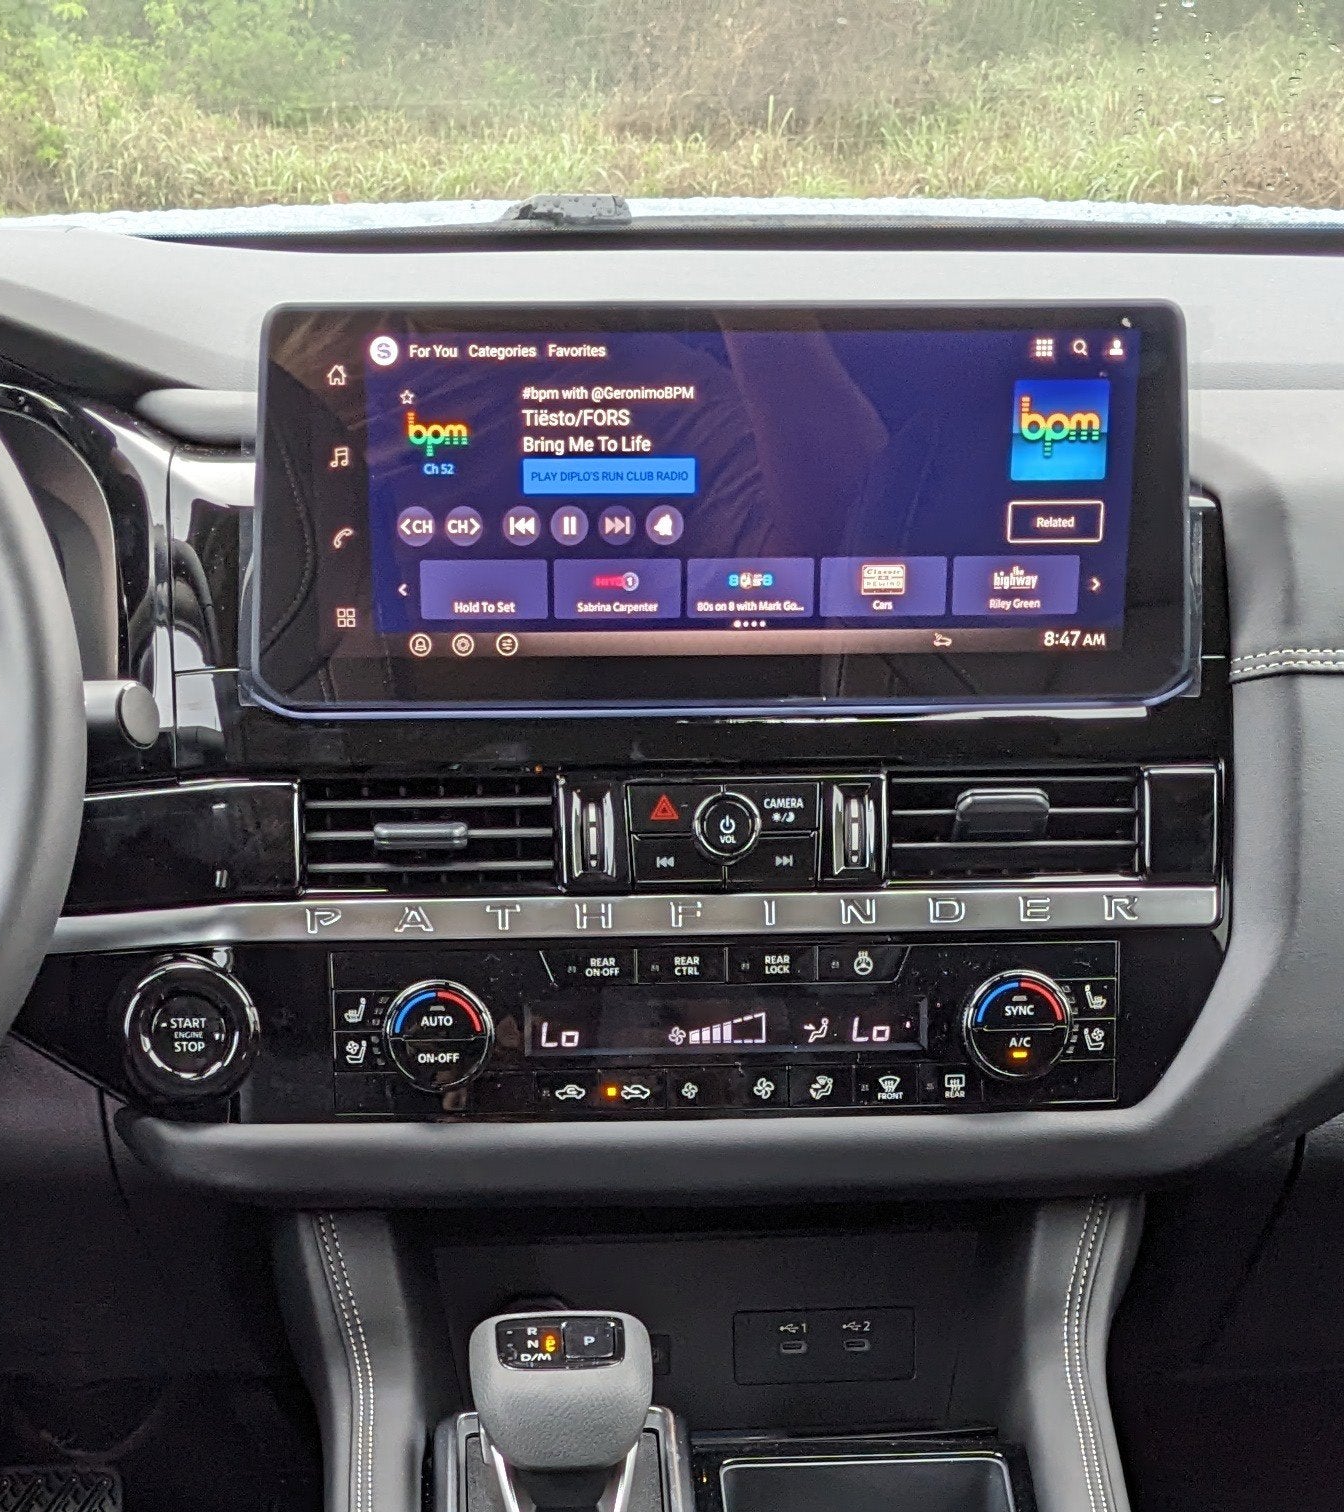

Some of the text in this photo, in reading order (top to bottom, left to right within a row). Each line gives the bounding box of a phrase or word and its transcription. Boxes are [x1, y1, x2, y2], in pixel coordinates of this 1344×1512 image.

[409, 344, 458, 358] For You
[468, 344, 536, 361] Categories
[548, 343, 606, 358] Favorites
[522, 386, 695, 403] #bpm with @GeronimoBPM
[522, 408, 631, 427] Tiësto/FORS
[1021, 396, 1100, 457] bpm
[407, 411, 468, 457] bpm
[523, 435, 651, 455] Bring Me To Life
[423, 463, 455, 475] Ch 52
[531, 471, 557, 482] PLAY
[602, 471, 624, 482] RUN
[626, 471, 654, 481] CLUB
[656, 470, 689, 481] RADIO
[1036, 516, 1075, 528] Related
[454, 602, 516, 614] Hold To Set
[577, 601, 659, 614] Sabrina Carpenter
[872, 600, 894, 611] Cars
[989, 598, 1041, 611] Riley Green
[1043, 630, 1106, 647] 8:47 AM
[763, 797, 805, 809] CAMERA
[719, 834, 737, 844] VOL
[305, 895, 1138, 934] PATHFINDER
[590, 957, 616, 967] REAR
[674, 956, 700, 966] REAR
[764, 955, 790, 965] REAR
[674, 966, 700, 976] CTRL
[764, 965, 790, 975] LOCK
[1004, 1005, 1035, 1017] SYNC
[169, 1017, 207, 1029] START
[420, 1015, 453, 1027] AUTO
[174, 1031, 204, 1039] ENGINE
[174, 1041, 206, 1053] STOP
[1008, 1036, 1031, 1048] A/C
[877, 1091, 904, 1100] FRONT
[944, 1090, 965, 1099] REAR
[526, 1327, 538, 1336] R
[526, 1339, 539, 1349] N
[583, 1336, 596, 1346] P
[520, 1353, 552, 1362] D/M
